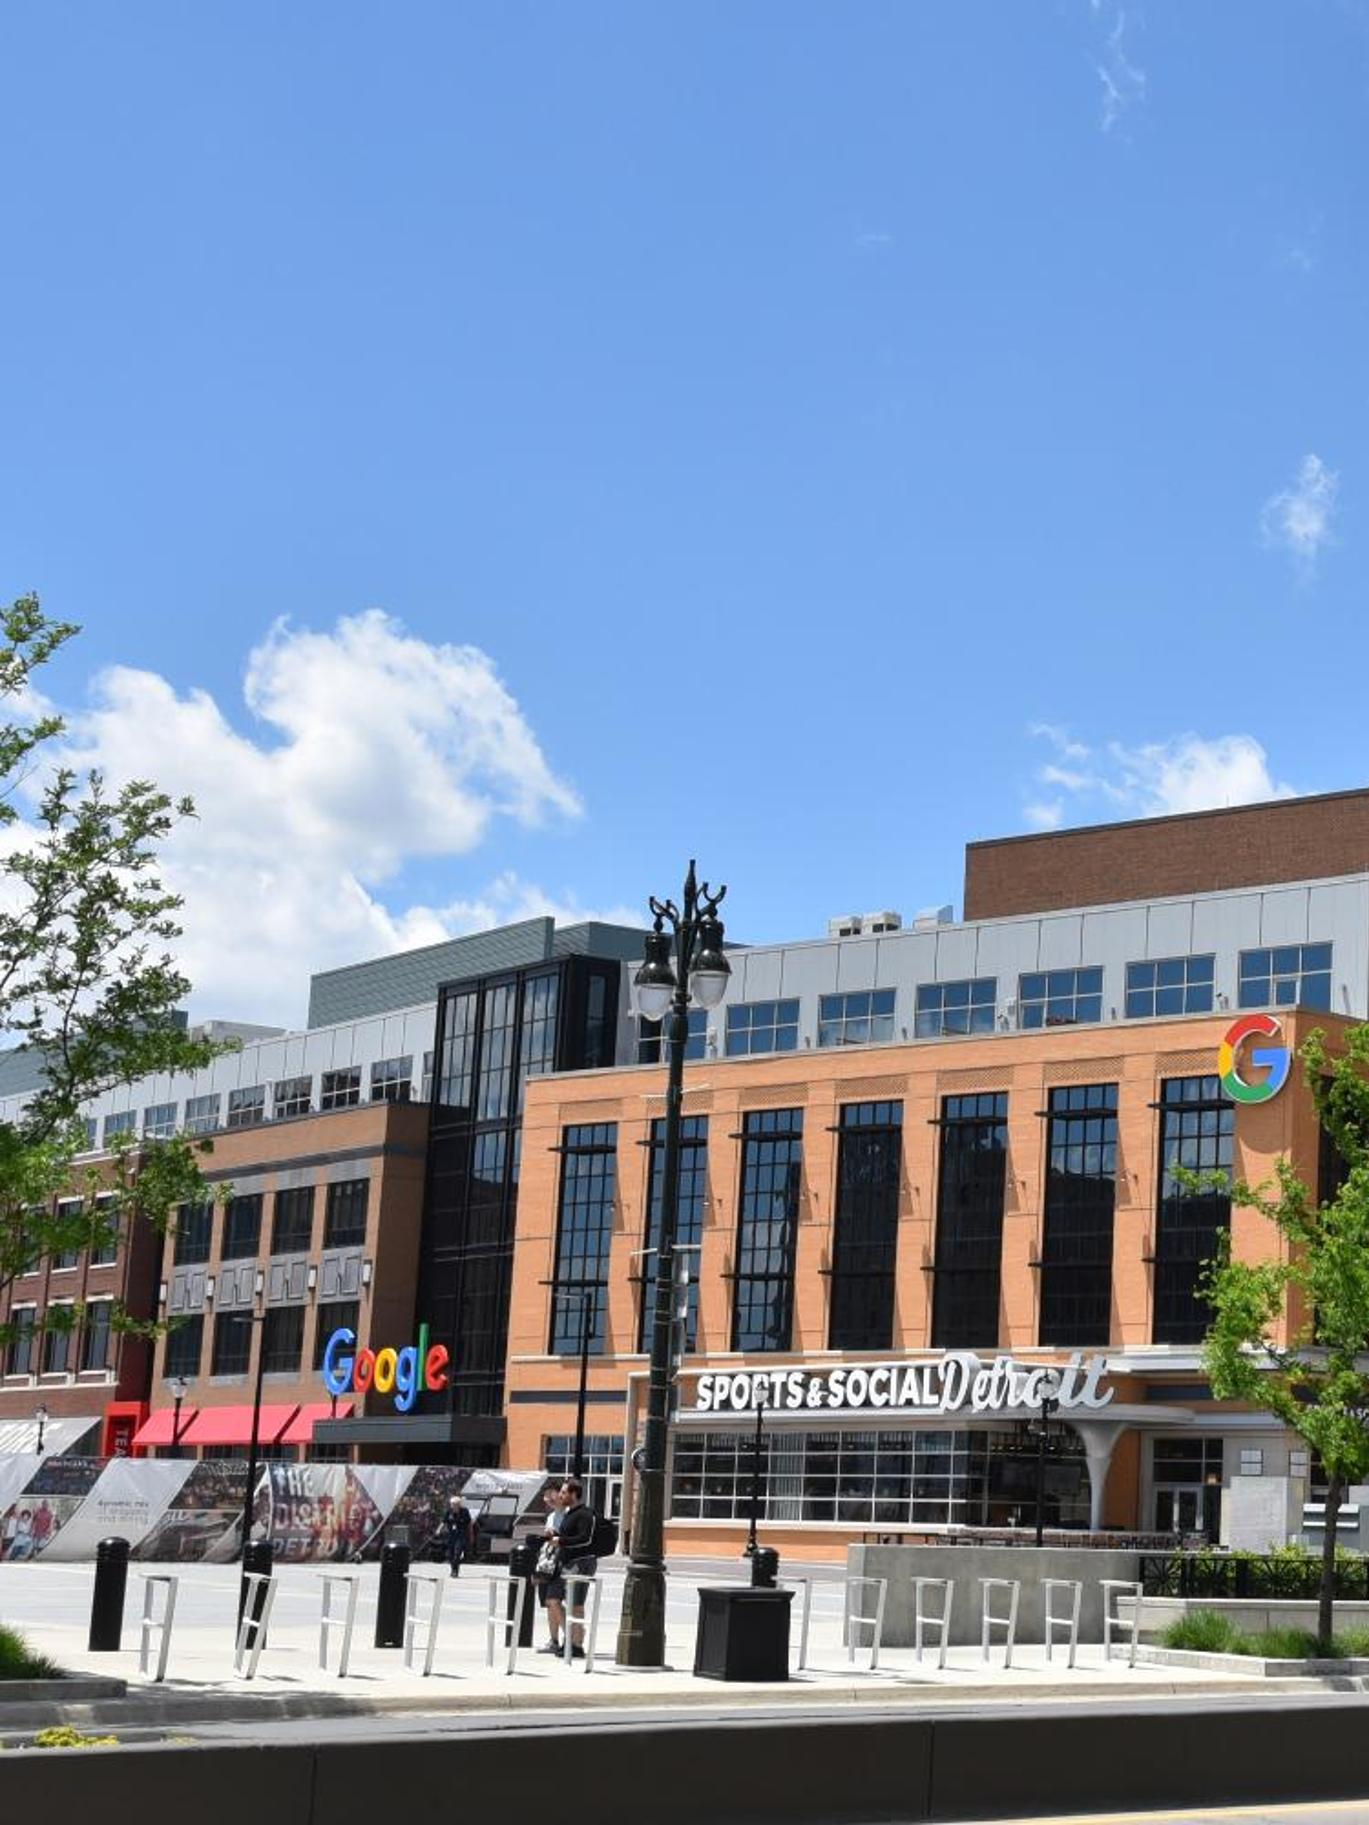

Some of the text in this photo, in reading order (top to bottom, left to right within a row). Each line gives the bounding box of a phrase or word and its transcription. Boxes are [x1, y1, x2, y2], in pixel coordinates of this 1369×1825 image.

[1218, 1014, 1291, 1104] G
[324, 1323, 449, 1412] Google
[697, 1352, 1114, 1413] SPORTS & SOCIAL Detroit
